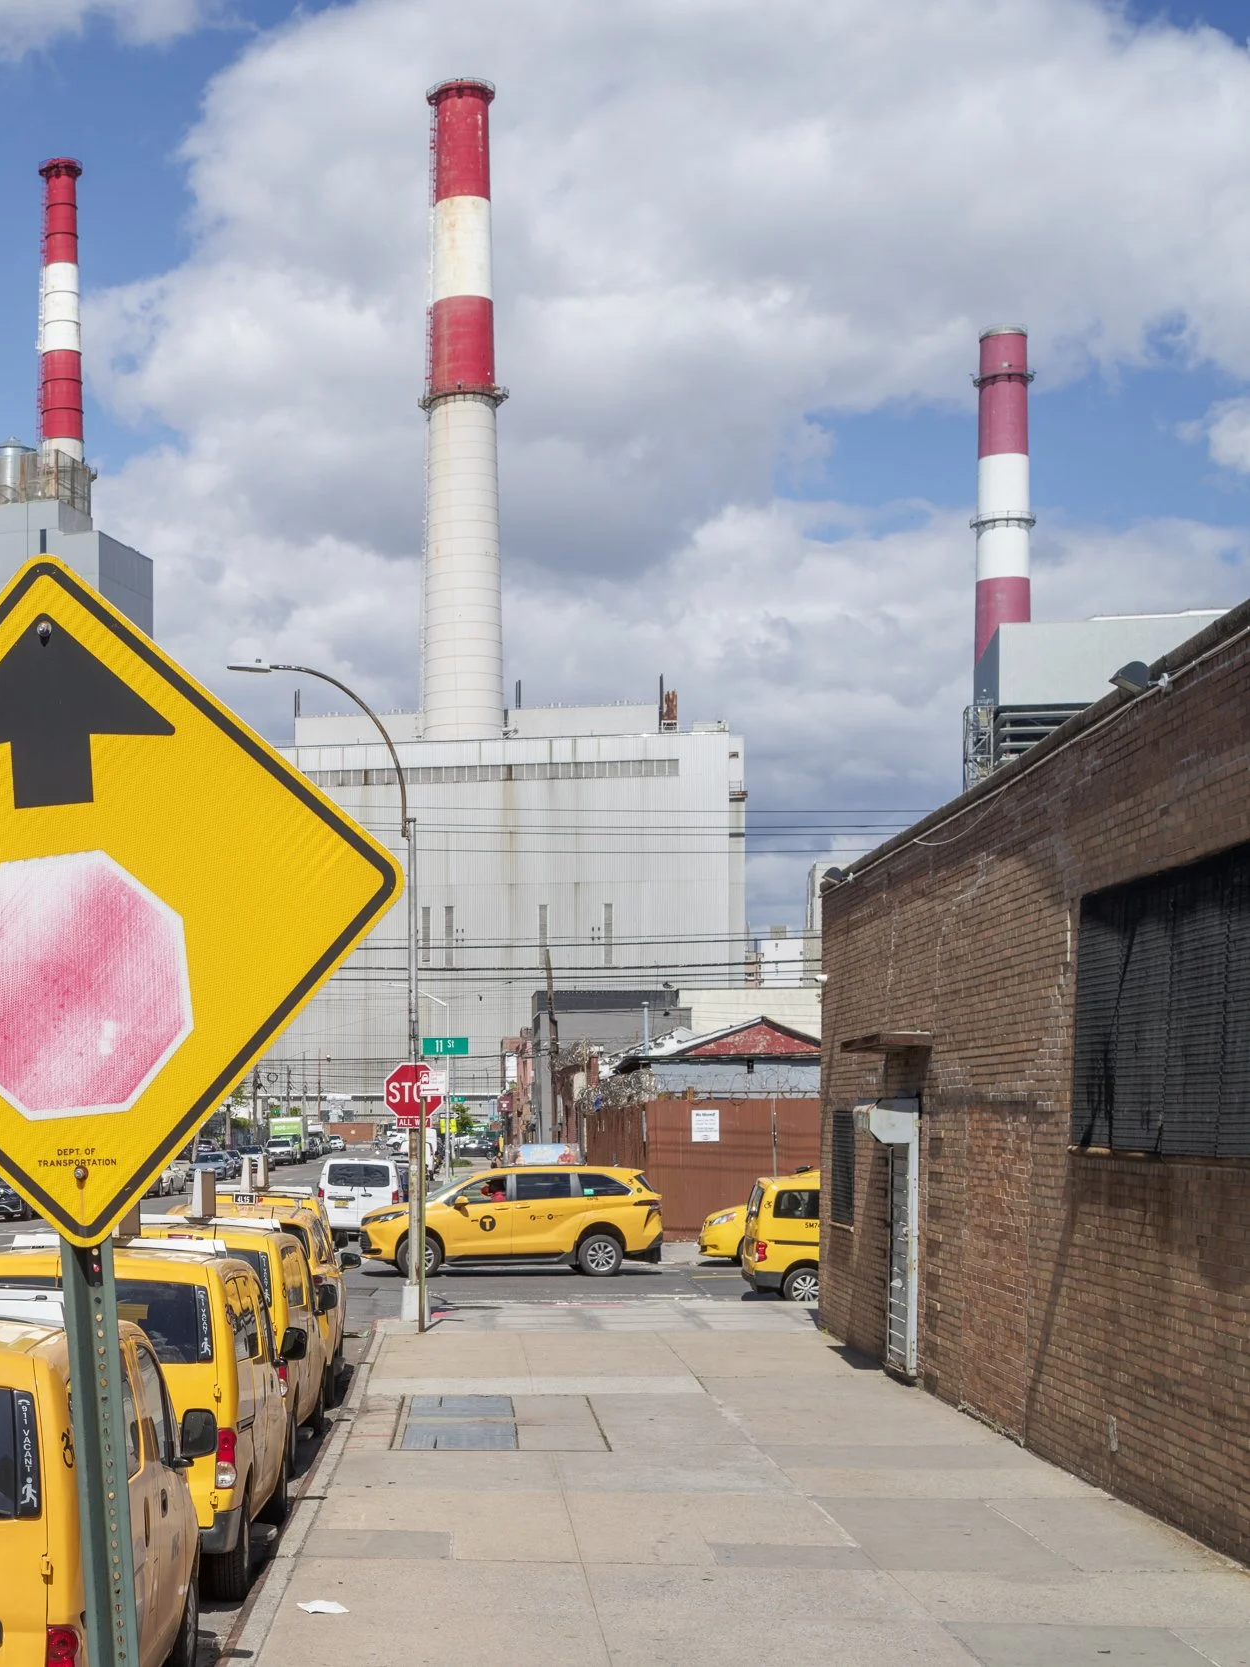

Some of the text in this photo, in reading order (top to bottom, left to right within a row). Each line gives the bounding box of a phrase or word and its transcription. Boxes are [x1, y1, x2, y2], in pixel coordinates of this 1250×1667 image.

[435, 1040, 454, 1053] 11 St
[388, 1081, 432, 1103] STO
[84, 1147, 96, 1155] OF
[37, 1158, 117, 1167] TRANSPORTATION
[22, 1429, 33, 1472] VACANT
